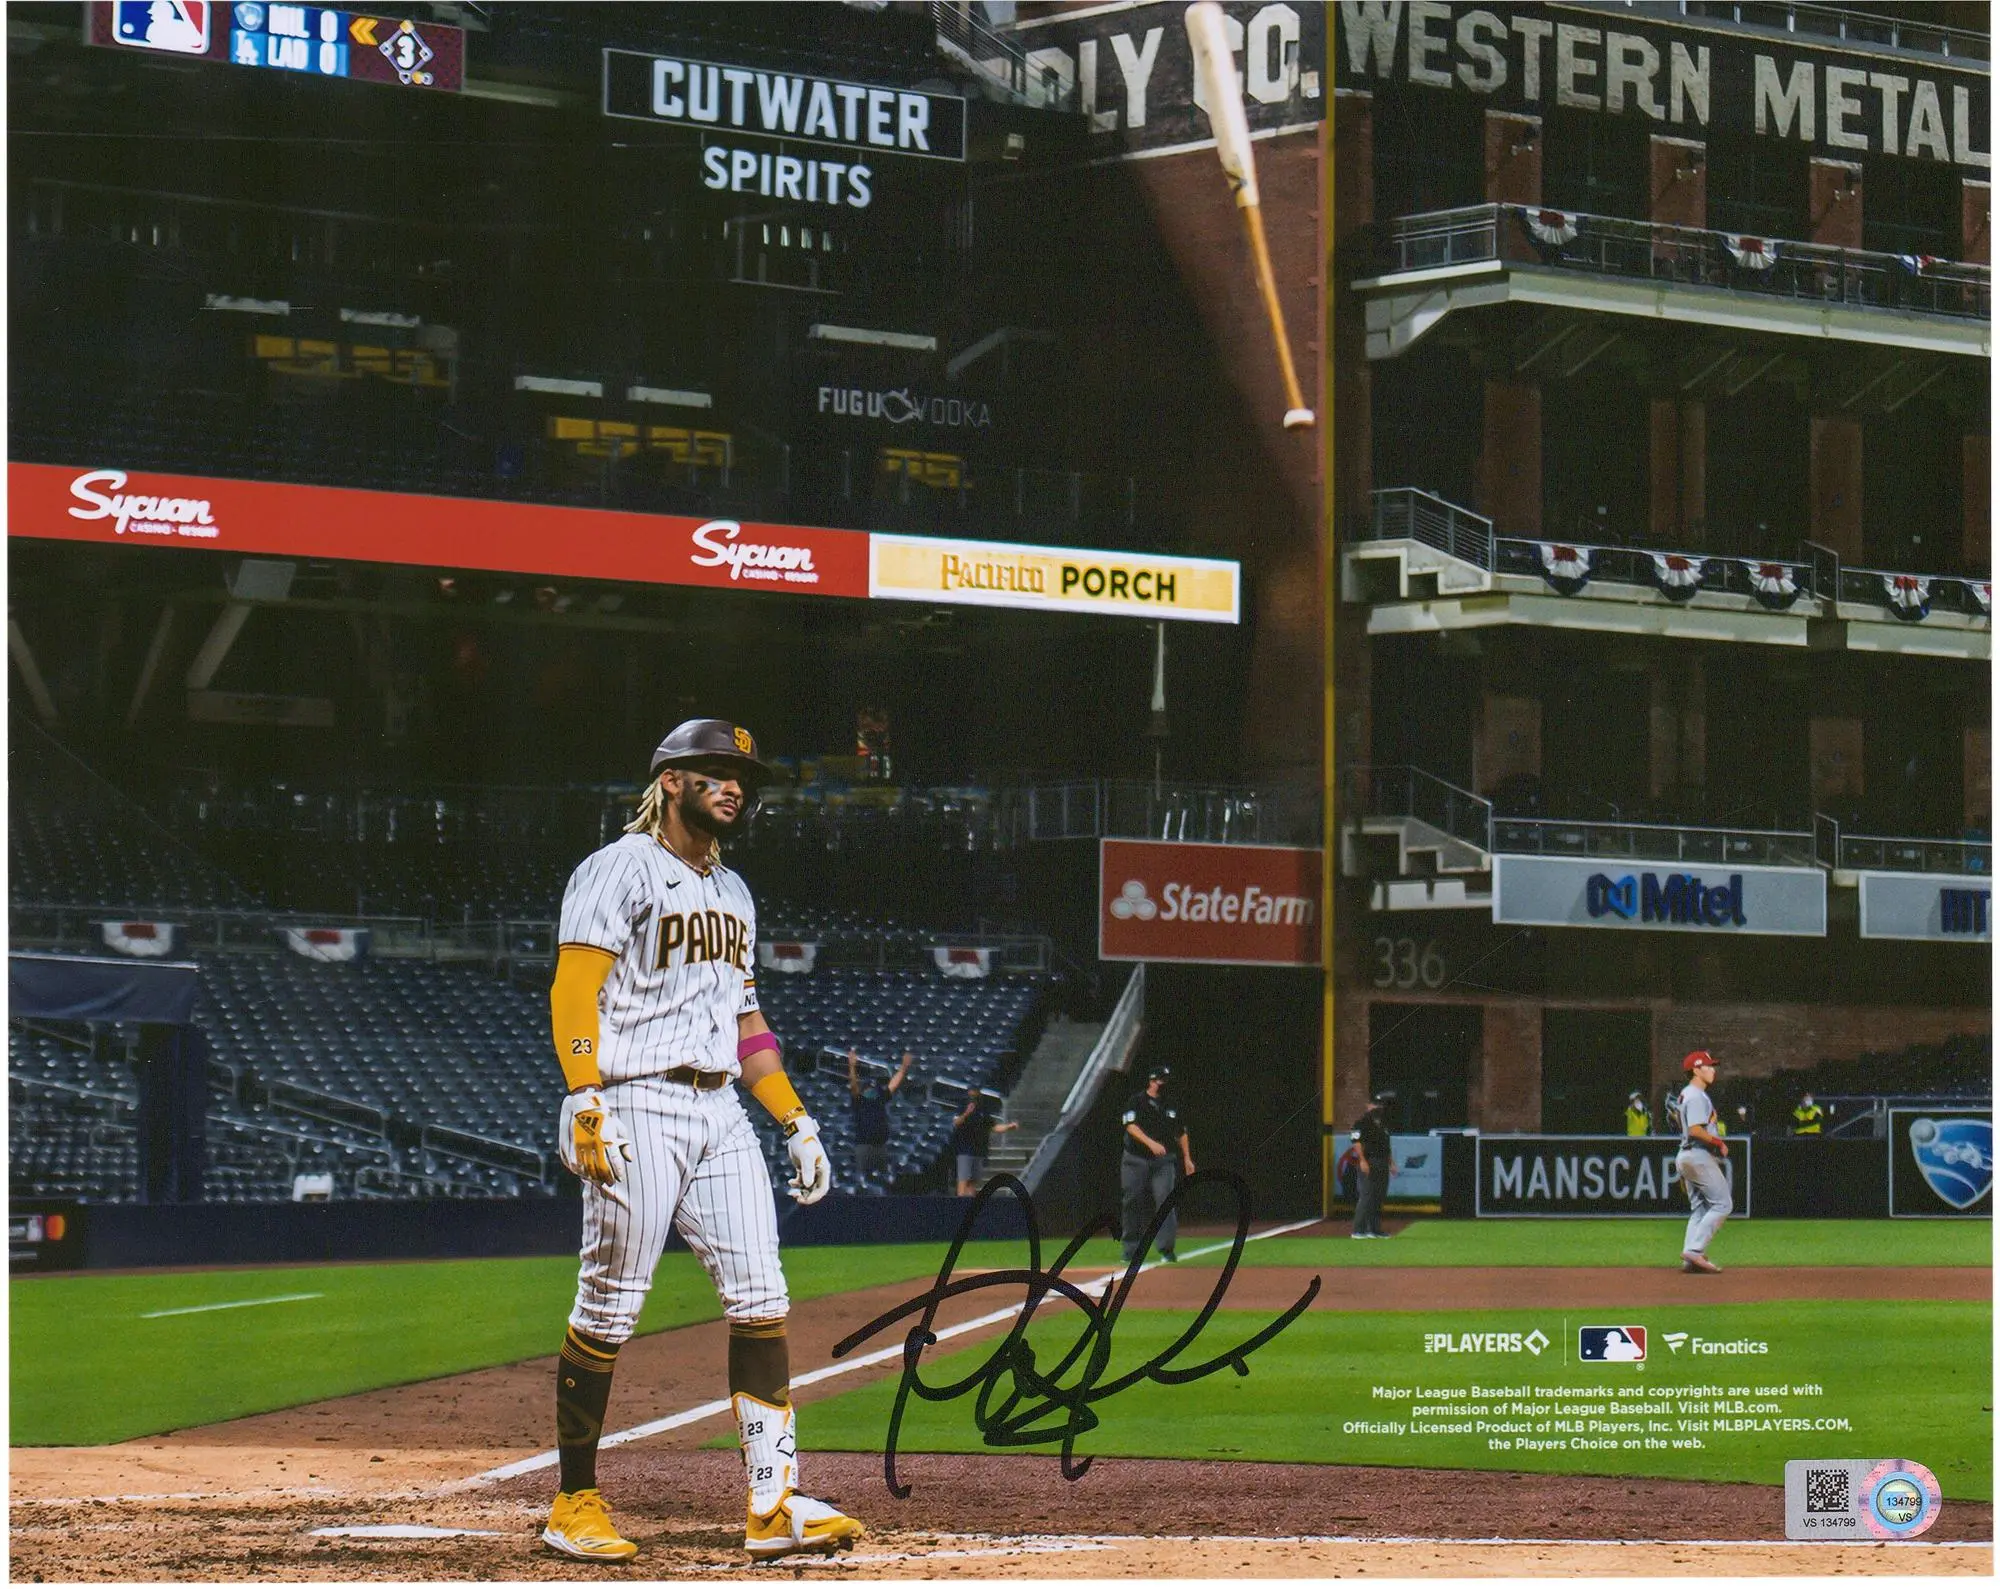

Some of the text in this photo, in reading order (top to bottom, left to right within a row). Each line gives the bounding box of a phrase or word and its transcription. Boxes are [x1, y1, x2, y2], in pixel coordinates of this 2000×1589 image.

[320, 10, 338, 42] 0
[319, 42, 337, 74] 0
[396, 35, 415, 68] 3
[1340, 2, 1991, 167] WESTERN METAL
[652, 58, 930, 151] CUTWATER
[703, 146, 872, 208] SPIRITS
[818, 386, 881, 418] FUGU
[68, 469, 215, 534] Sycuan
[691, 520, 815, 580] Sycuan
[1060, 564, 1176, 602] PORCH
[1641, 872, 1748, 927] Mitel
[1373, 937, 1446, 988] 336
[571, 1038, 592, 1055] 23
[1493, 1156, 1733, 1200] MANSCAP
[747, 1420, 764, 1436] 23
[756, 1466, 773, 1481] 23
[1886, 1496, 1922, 1507] 134799
[1898, 1512, 1913, 1523] VS
[1803, 1518, 1856, 1528] VS 134799
